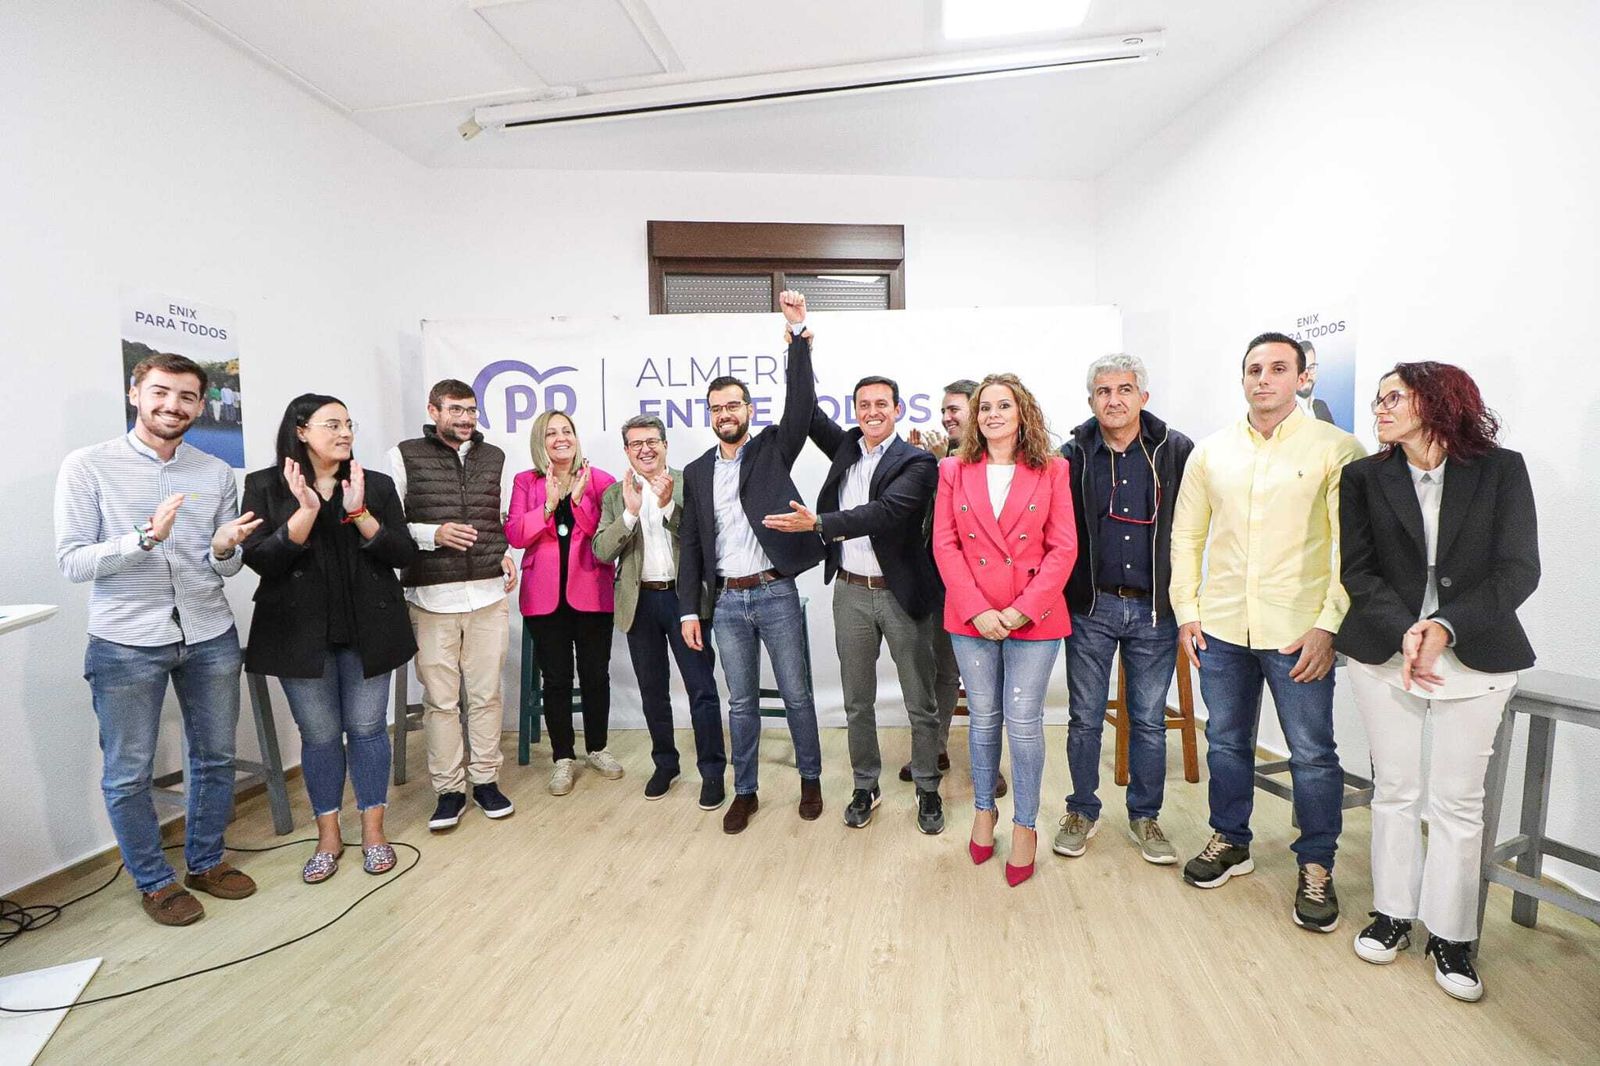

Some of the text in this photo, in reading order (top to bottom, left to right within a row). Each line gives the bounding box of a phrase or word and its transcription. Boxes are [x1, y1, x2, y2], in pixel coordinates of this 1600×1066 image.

[169, 304, 197, 319] ENIX
[1297, 313, 1319, 327] ENIX
[135, 311, 227, 340] PARA TODOS
[1305, 320, 1346, 339] TODOS
[635, 348, 819, 387] ALMERÍ
[640, 396, 773, 428] ENTE
